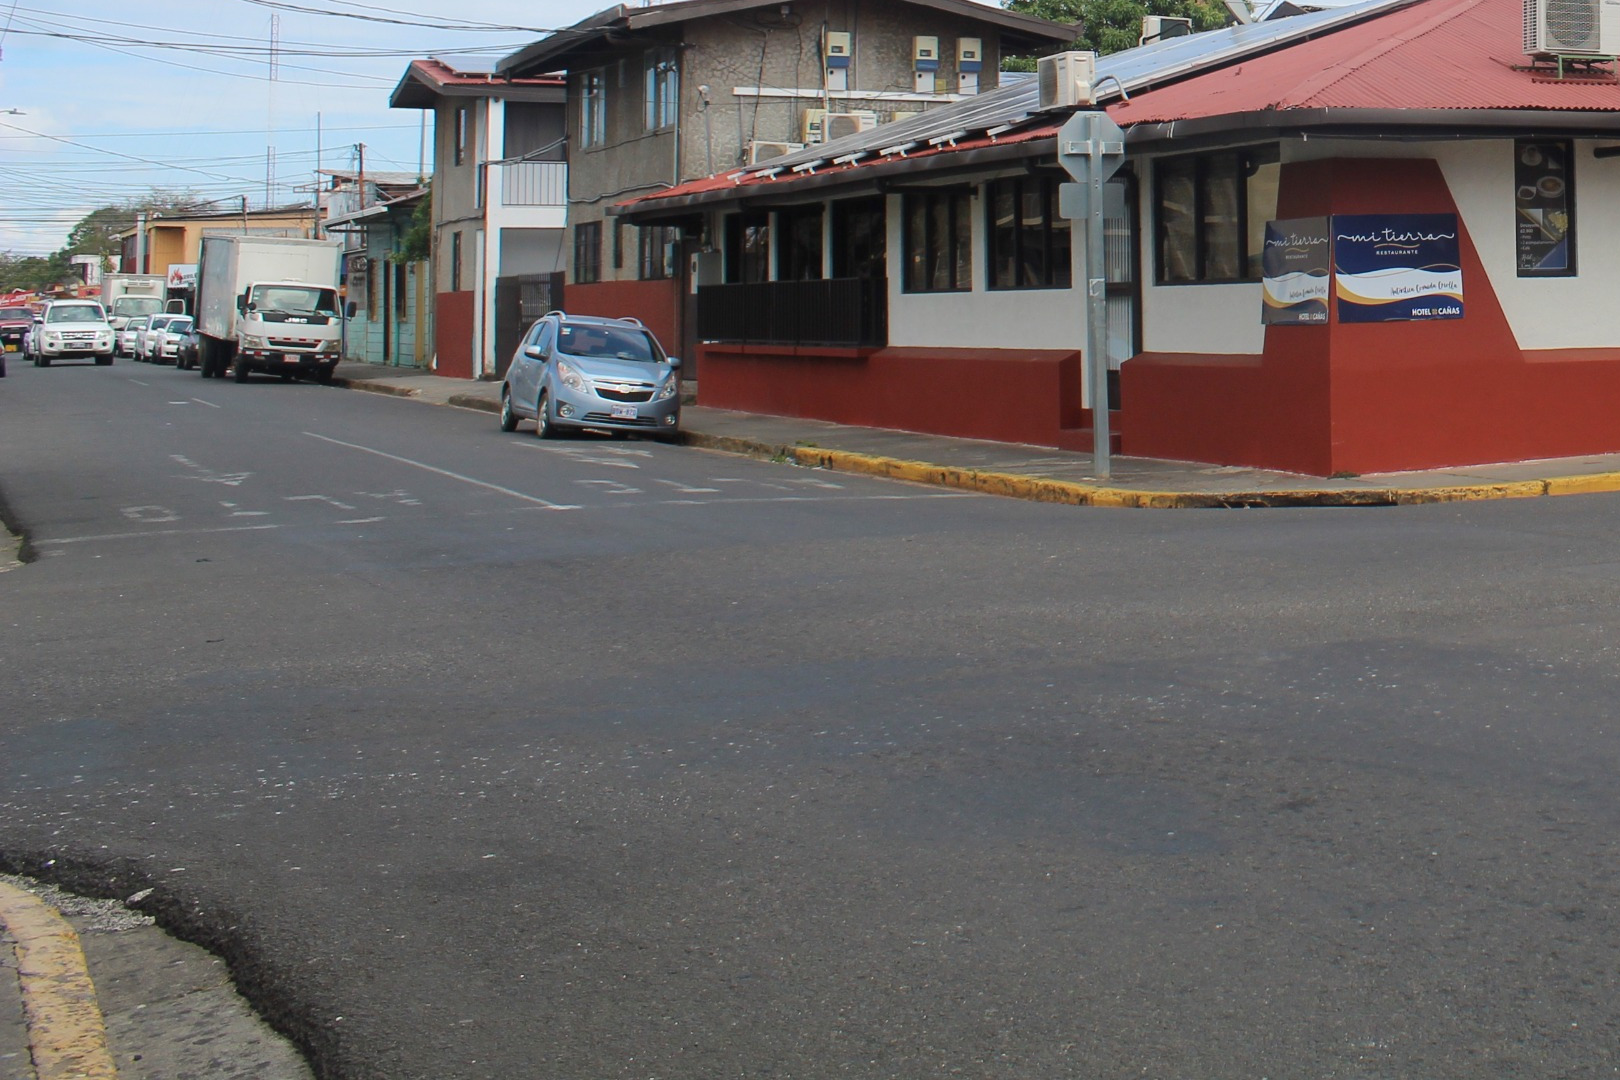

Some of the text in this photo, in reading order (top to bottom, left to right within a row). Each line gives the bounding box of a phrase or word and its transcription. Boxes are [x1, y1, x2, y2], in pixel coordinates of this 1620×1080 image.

[1268, 232, 1326, 247] mi tierra
[1340, 228, 1452, 242] mi tierra
[1412, 306, 1460, 316] HOTEL CAÑAS
